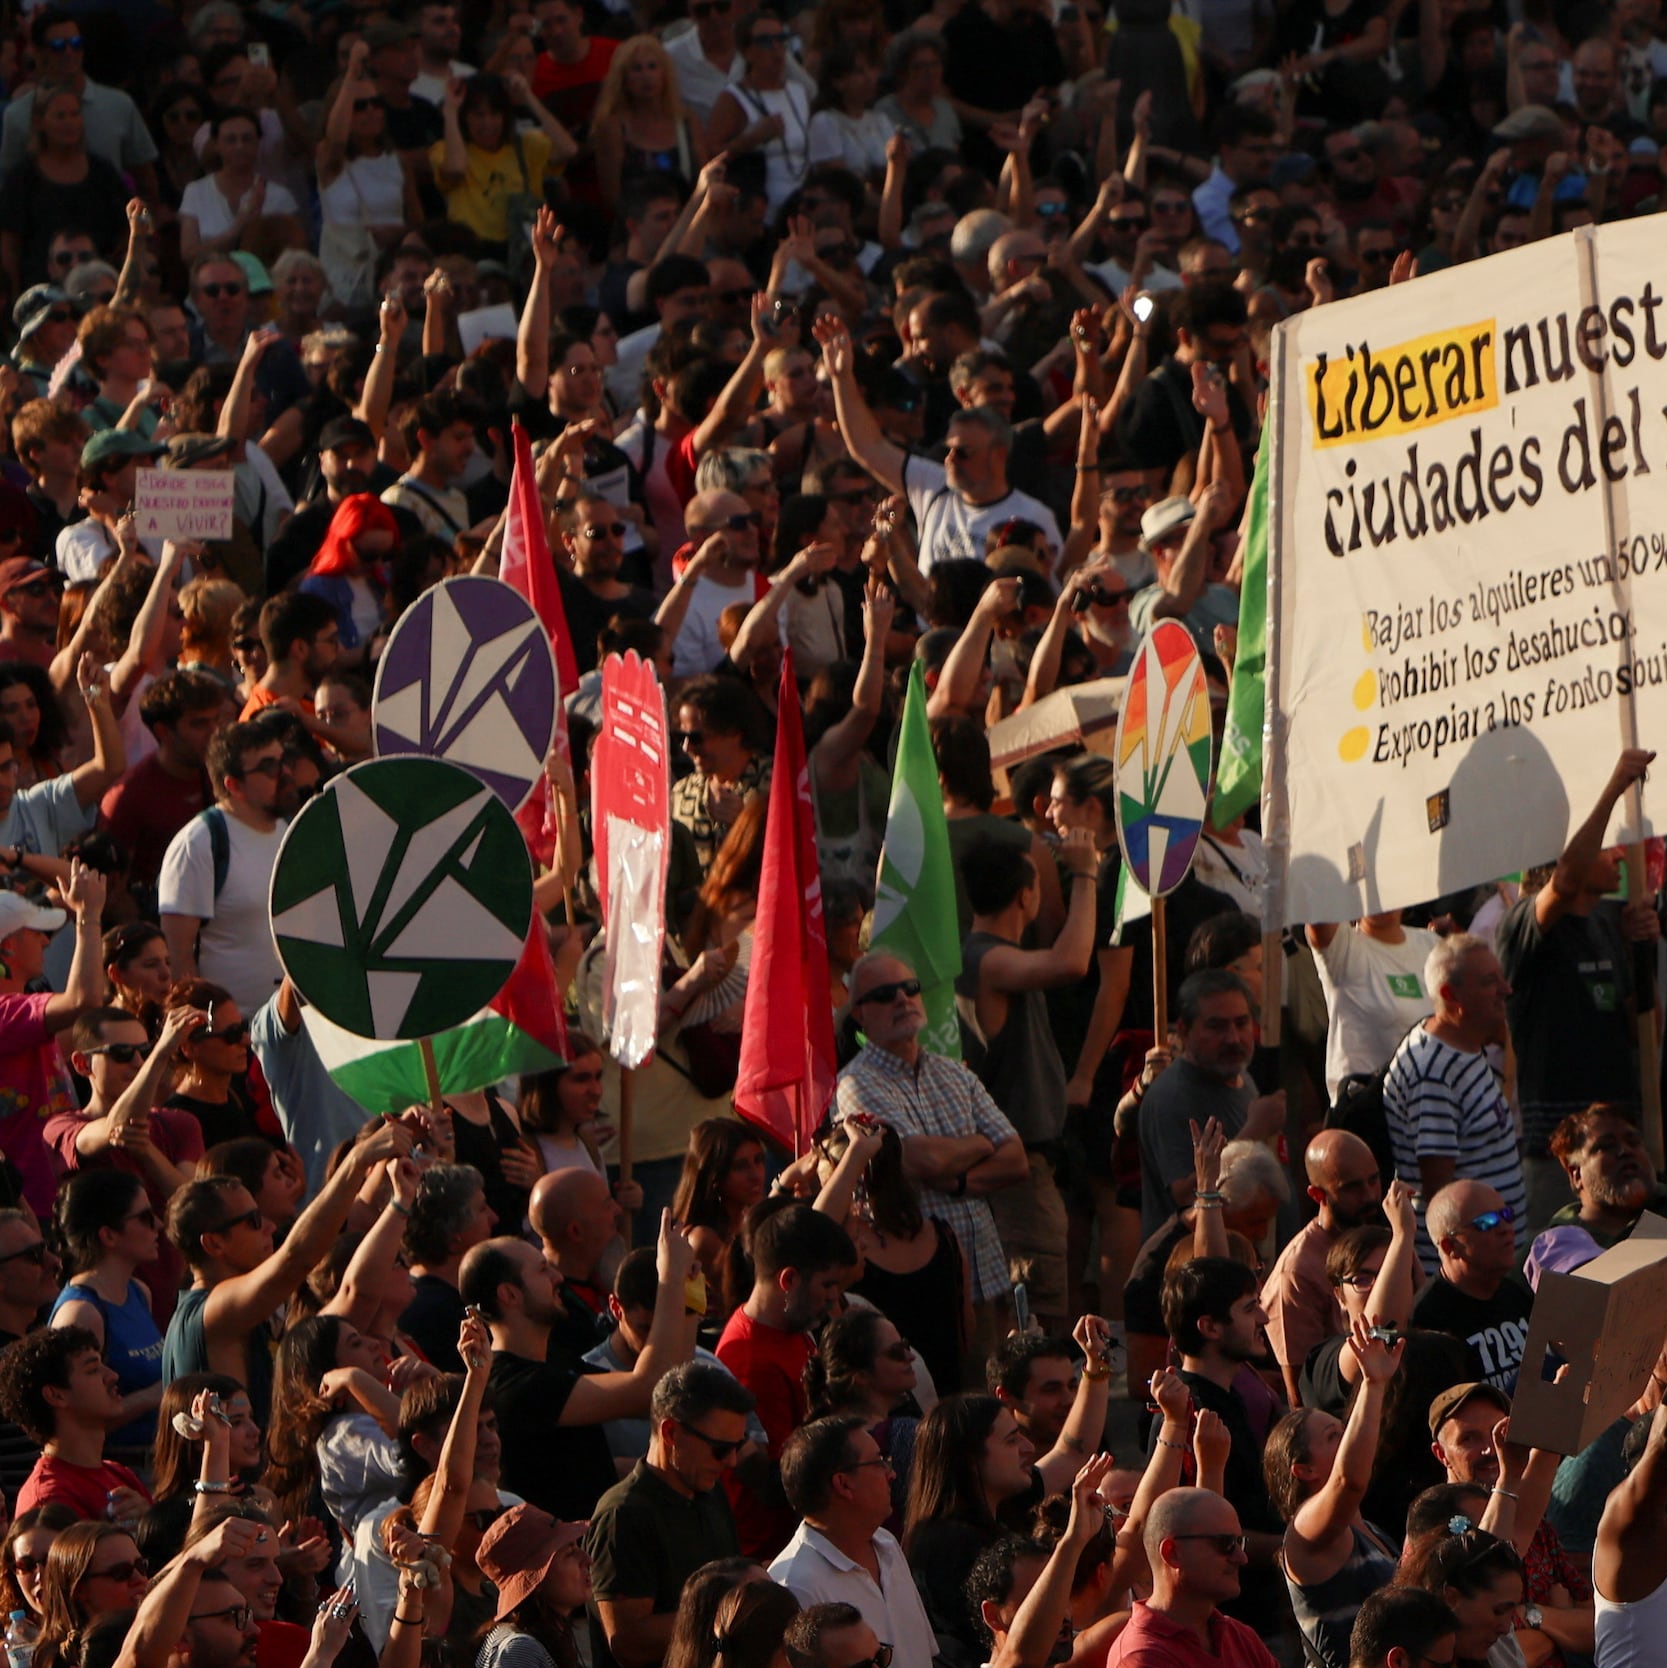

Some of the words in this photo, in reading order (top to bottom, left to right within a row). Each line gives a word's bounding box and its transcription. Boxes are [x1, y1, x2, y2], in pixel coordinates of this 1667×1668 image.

[1314, 328, 1491, 441] Liberar
[1324, 427, 1544, 558] ciudades
[1557, 387, 1650, 494] del
[1367, 602, 1423, 654] Bajar
[1430, 596, 1463, 635] los
[1469, 564, 1574, 627] alquileres
[1464, 643, 1500, 681] los
[1372, 703, 1479, 768] Expropiar
[1487, 702, 1497, 732] a
[1503, 691, 1535, 728] los
